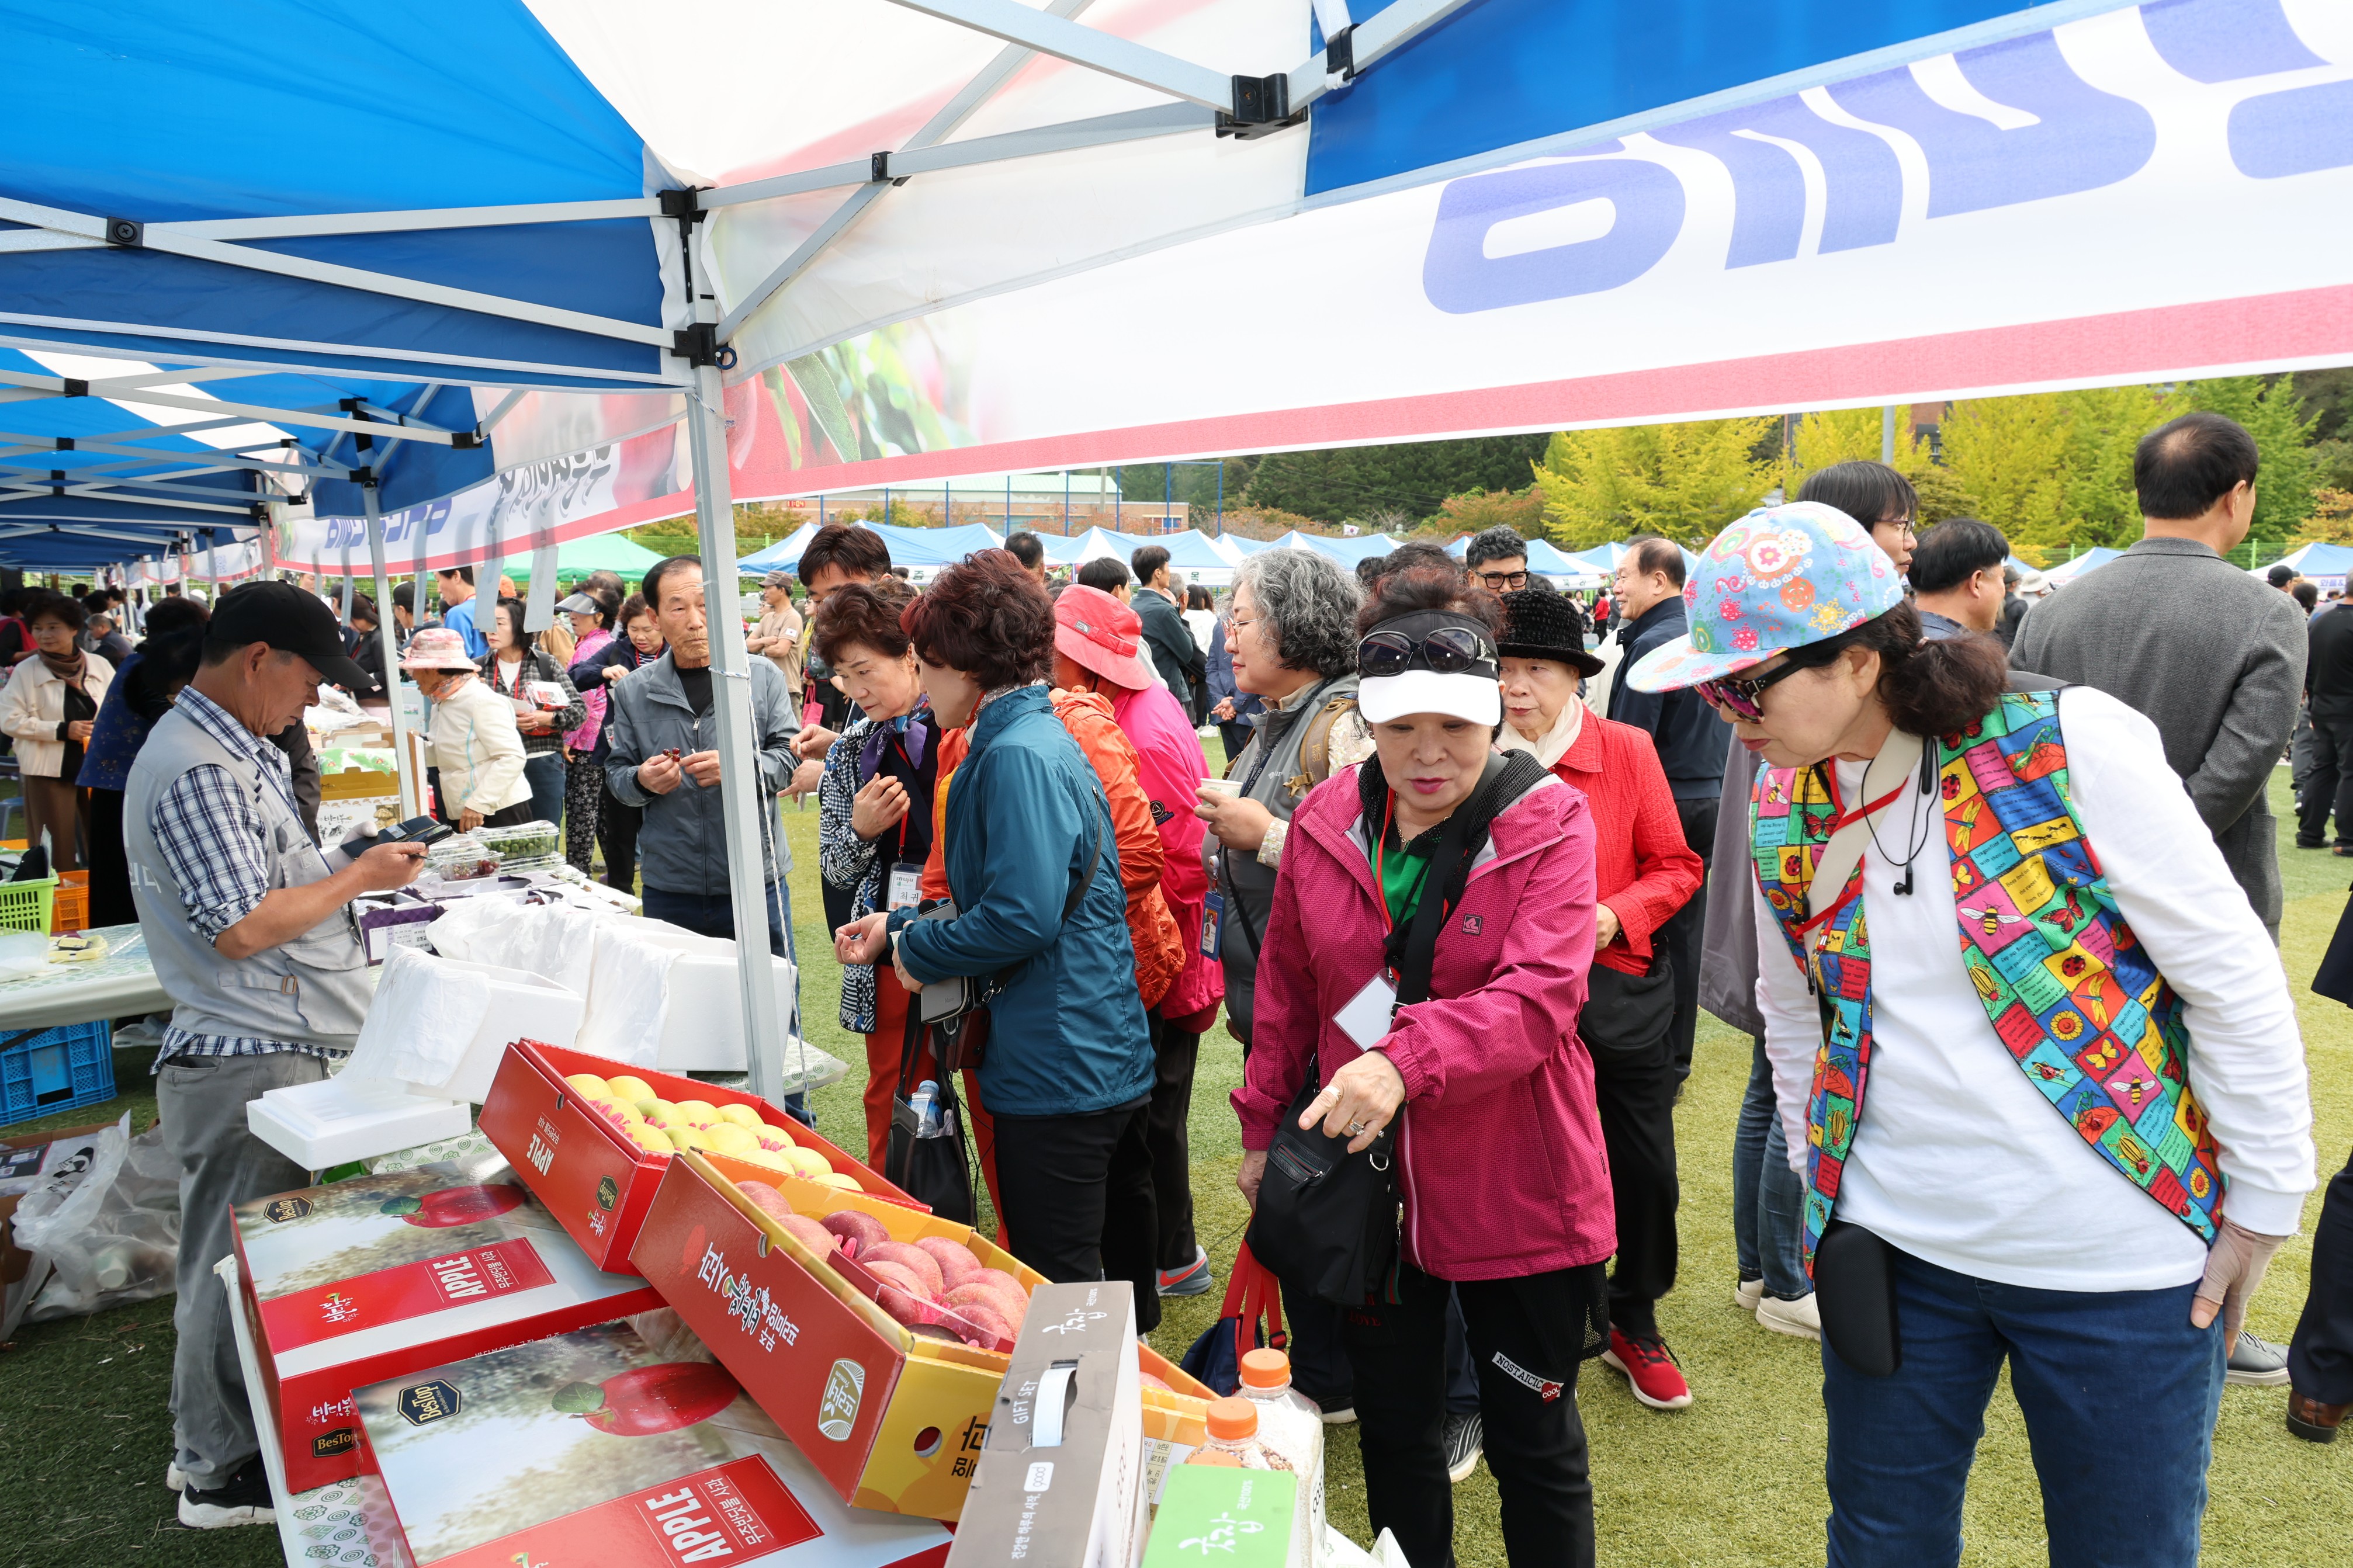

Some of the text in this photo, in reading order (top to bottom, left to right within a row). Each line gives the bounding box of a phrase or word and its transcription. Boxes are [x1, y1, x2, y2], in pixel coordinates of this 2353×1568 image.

[1253, 768, 1262, 780] CULTURE
[1974, 841, 1999, 858] Dragonflies
[1991, 853, 2002, 861] their
[2005, 879, 2017, 887] Bees
[2026, 896, 2037, 904] from
[2016, 941, 2030, 952] during
[2005, 965, 2013, 973] and
[2014, 953, 2028, 967] colored
[527, 1133, 555, 1177] APPLE
[598, 1182, 617, 1207] BesTop
[278, 1199, 298, 1222] BesTop
[432, 1257, 487, 1298] APPLE
[697, 1241, 728, 1293] 사과
[1086, 1288, 1098, 1306] 국산100%
[765, 1302, 799, 1347] 프리미엄
[1348, 1309, 1382, 1327] LOVE
[757, 1326, 778, 1353] 무주
[412, 1386, 442, 1421] BesTop
[1013, 1379, 1039, 1425] GIFT SET
[1542, 1387, 1560, 1399] COOL
[1236, 1479, 1253, 1511] 국산100%
[705, 1477, 767, 1546] 무주반딧불 사과
[645, 1487, 734, 1564] APPLE
[1011, 1536, 1029, 1560] 건강한
[1021, 1508, 1035, 1536] 하루의
